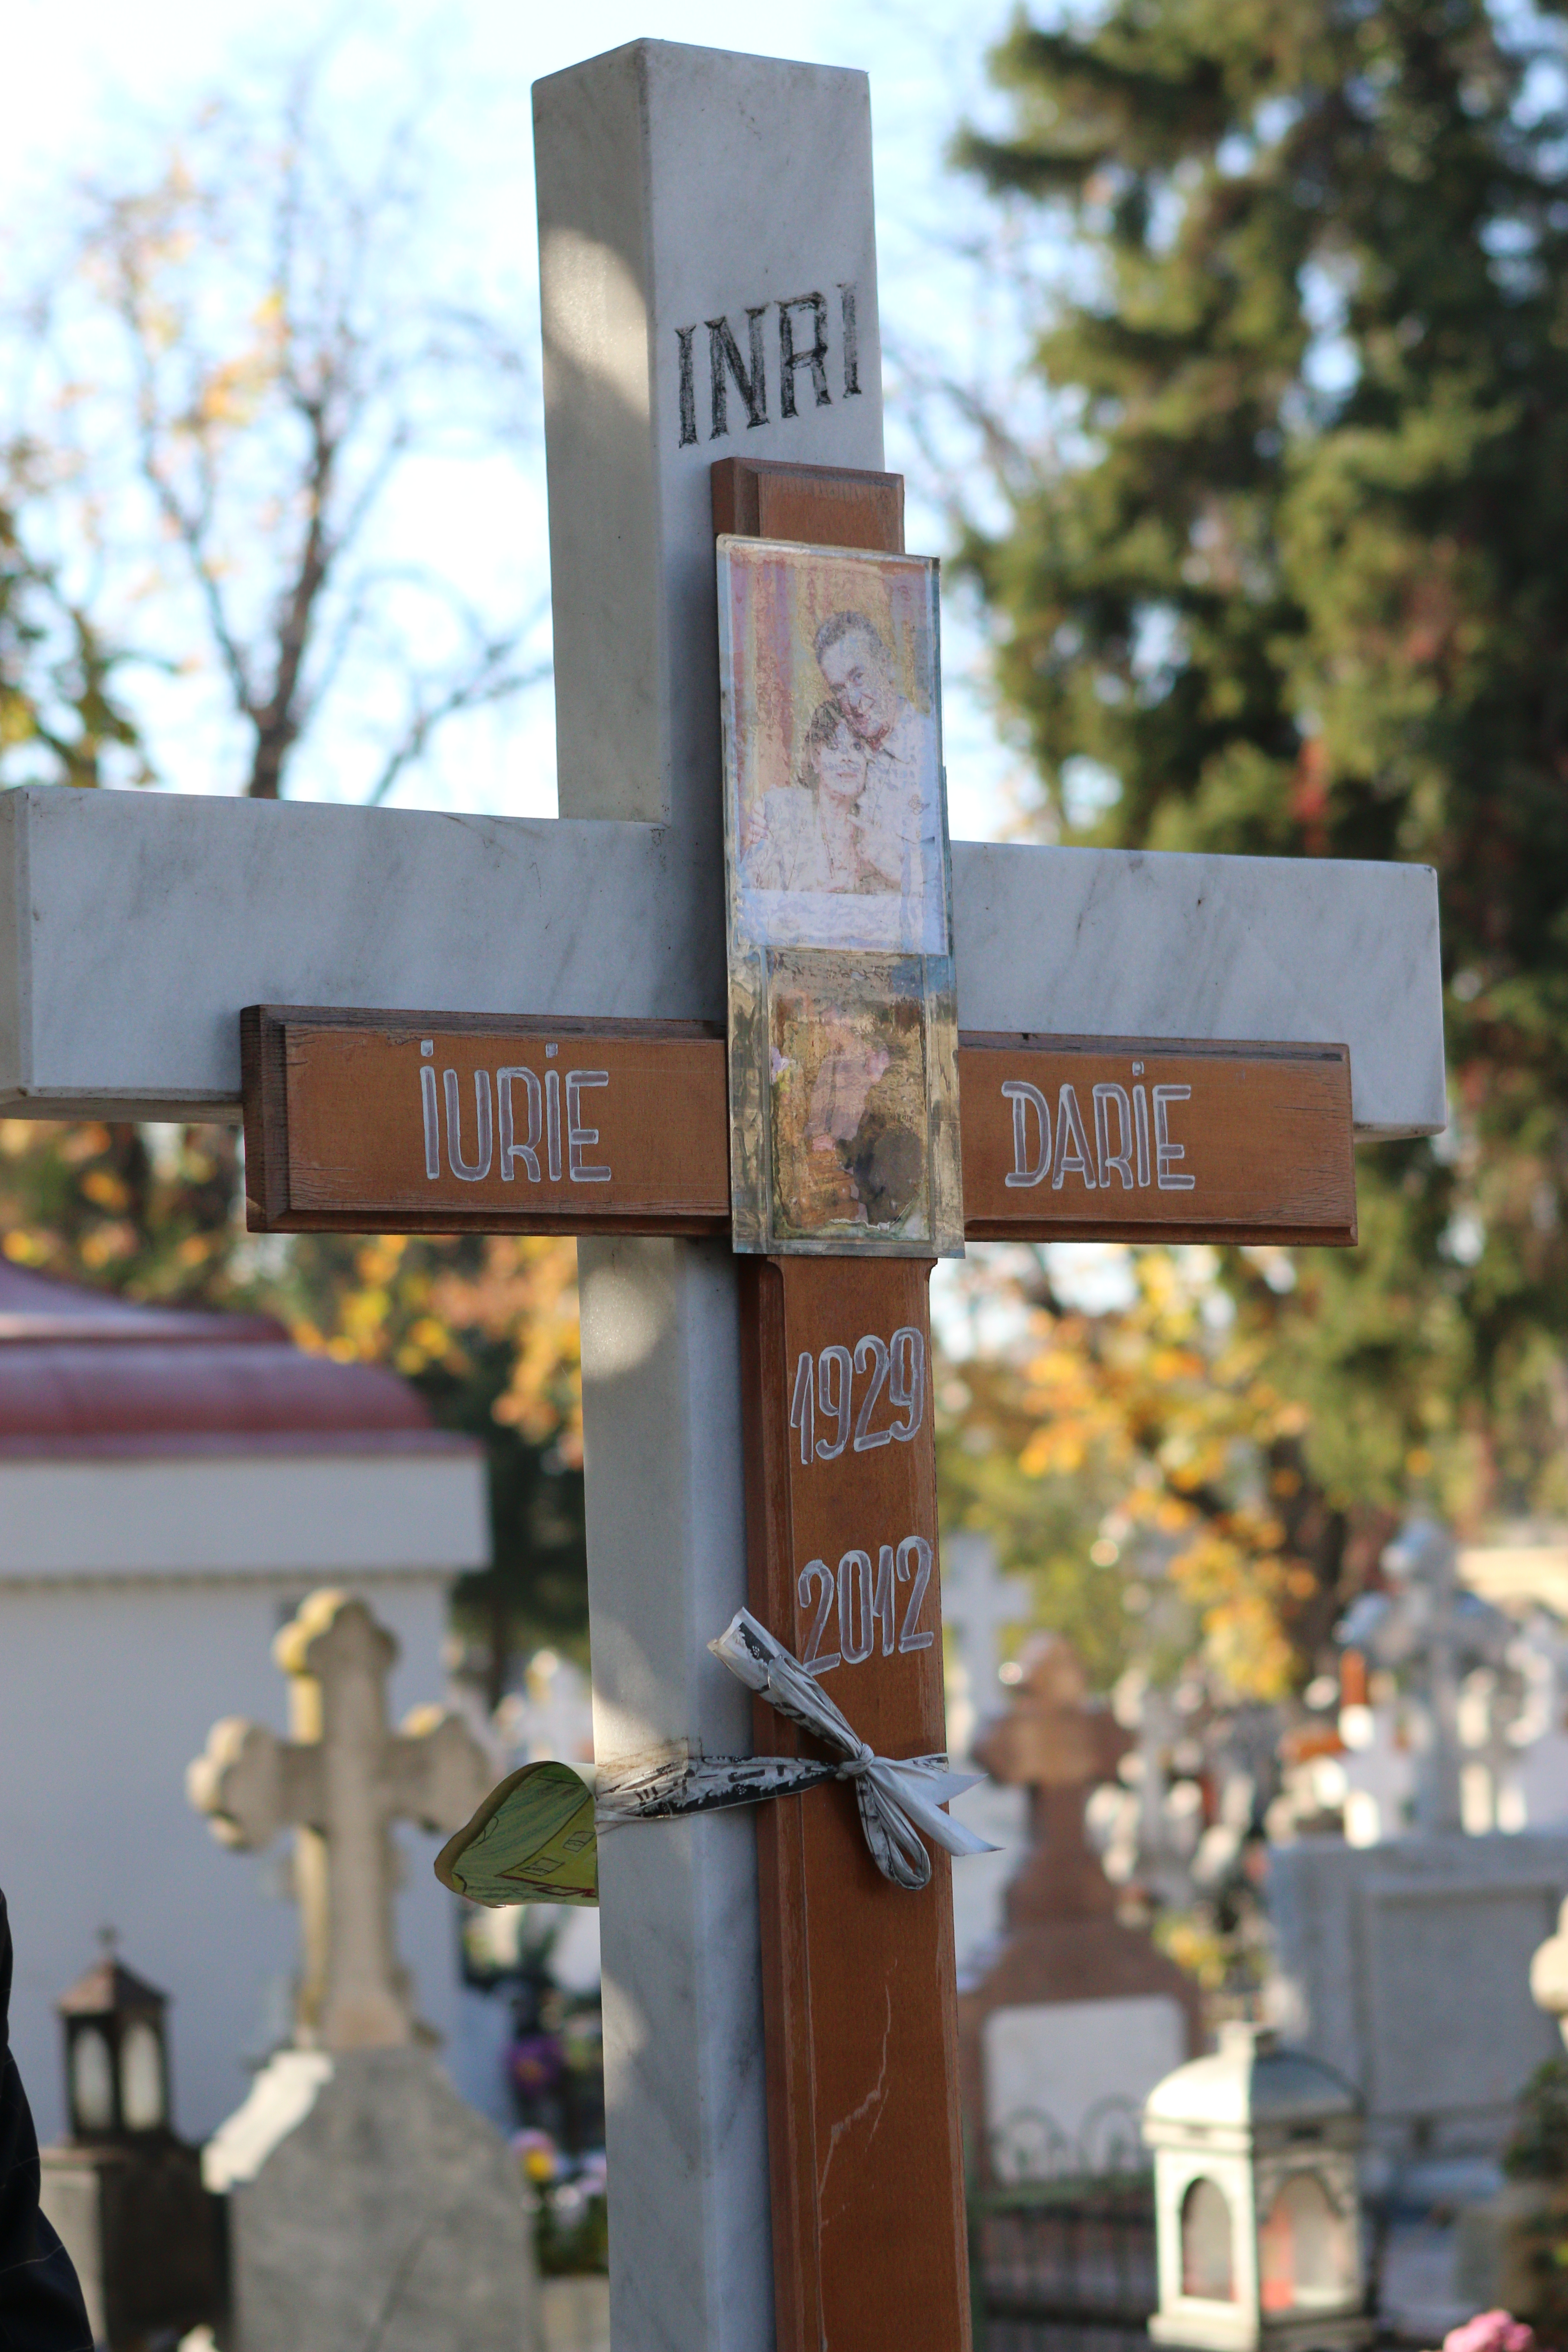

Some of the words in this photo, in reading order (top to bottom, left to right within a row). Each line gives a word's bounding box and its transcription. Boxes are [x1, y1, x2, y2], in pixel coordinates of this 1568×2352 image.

[674, 281, 862, 449] INRI
[790, 1326, 924, 1465] 1929
[798, 1535, 934, 1677] 2012
